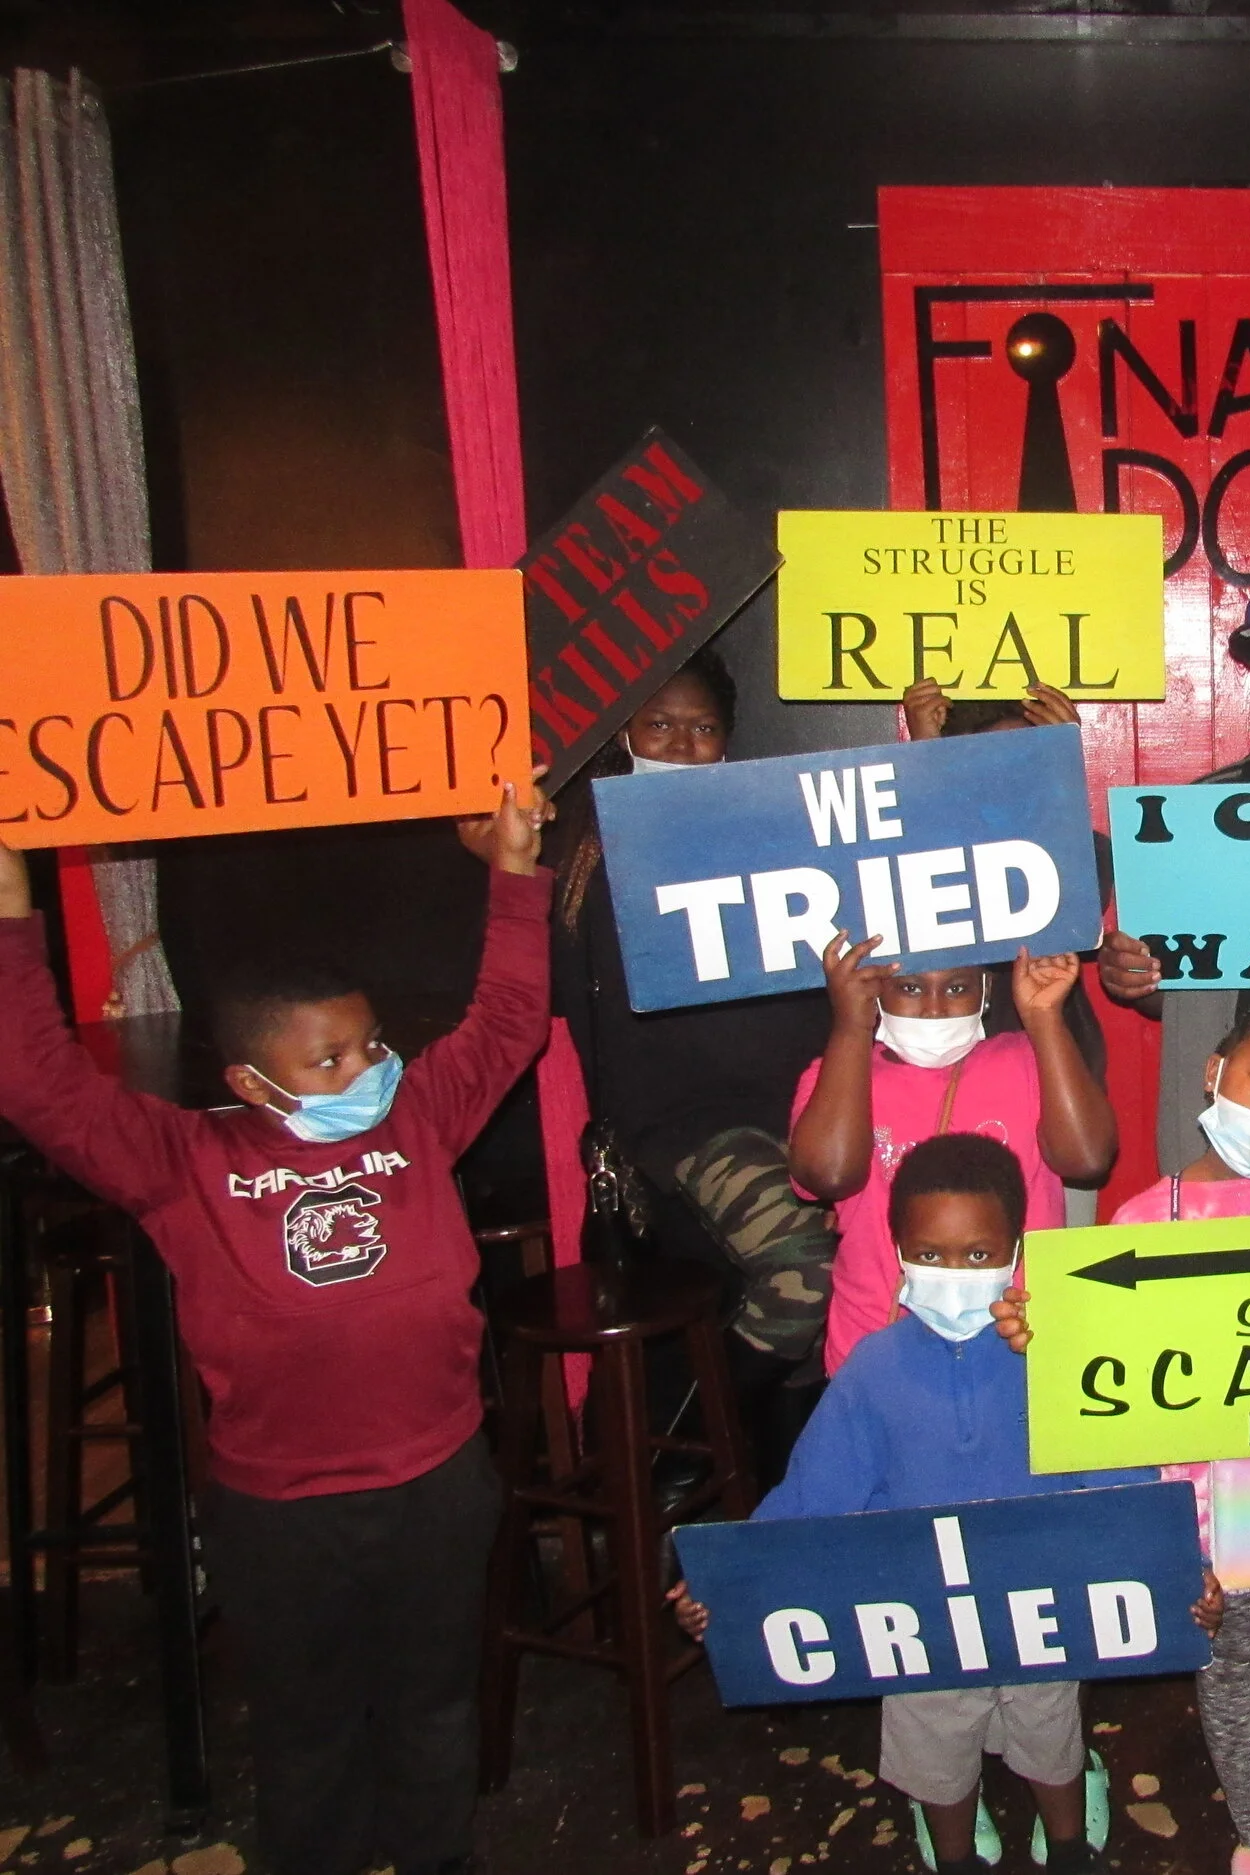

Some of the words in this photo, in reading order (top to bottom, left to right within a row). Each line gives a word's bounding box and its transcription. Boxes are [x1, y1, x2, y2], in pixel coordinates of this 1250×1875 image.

[526, 441, 704, 624] TEAM
[863, 548, 1076, 577] STRUGGLE
[932, 518, 1008, 544] THE
[955, 579, 987, 606] IS
[99, 593, 230, 701] DID
[251, 591, 391, 694] WE
[822, 611, 1120, 690] REAL
[322, 692, 508, 798] YET?
[799, 763, 903, 847] WE
[1135, 796, 1174, 843] I
[656, 839, 1061, 982] TRIED
[933, 1516, 970, 1587] I
[762, 1580, 1159, 1685] CRIED
